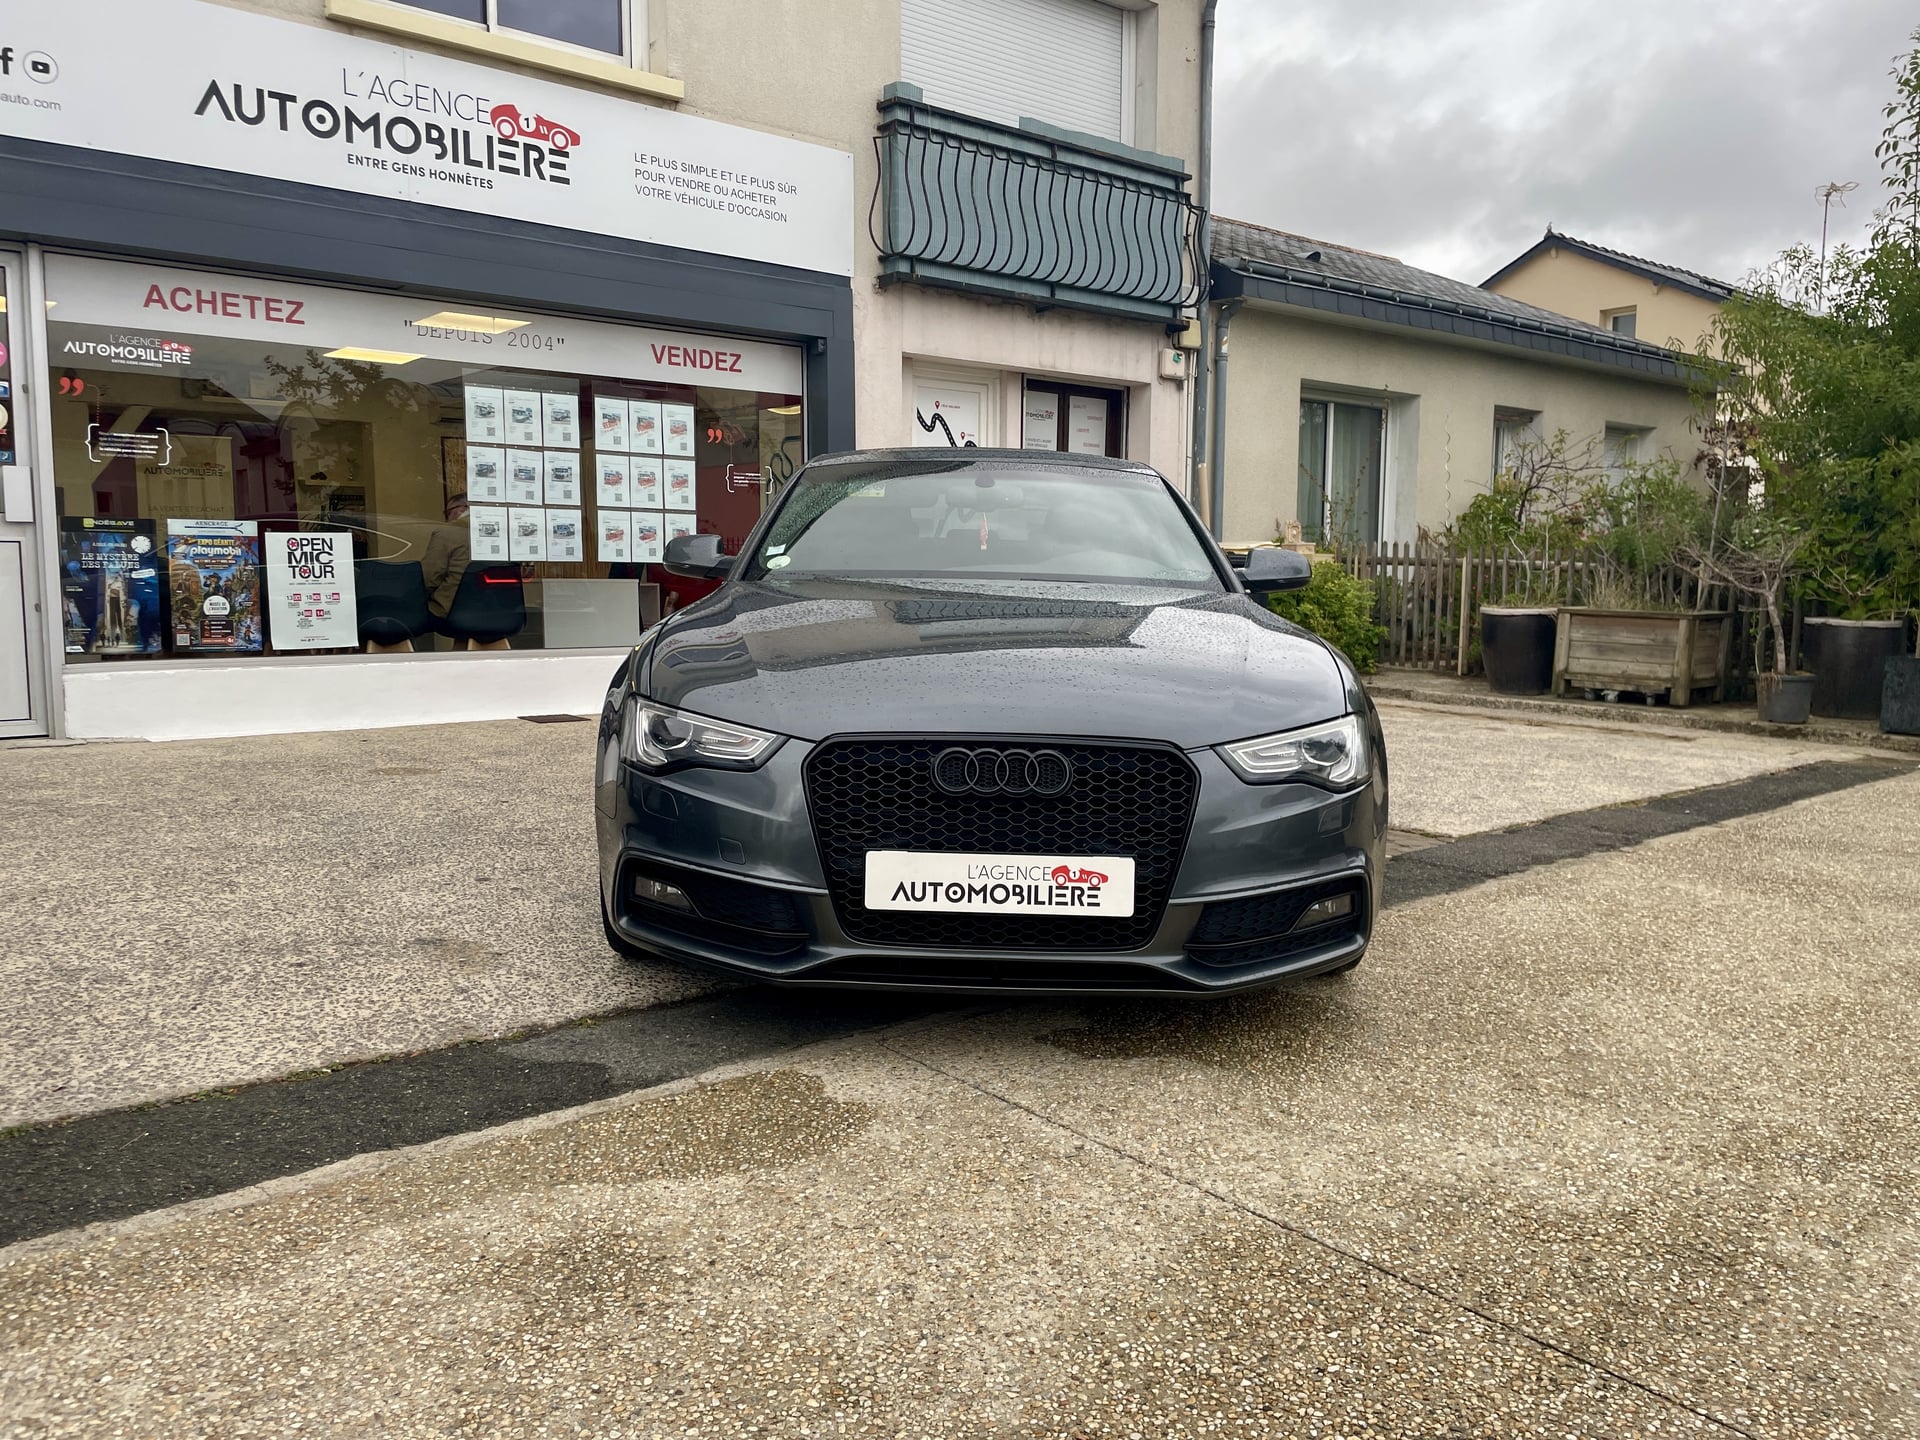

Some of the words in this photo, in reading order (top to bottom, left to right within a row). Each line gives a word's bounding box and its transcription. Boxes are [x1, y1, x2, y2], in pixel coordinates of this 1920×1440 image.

[343, 67, 491, 126] L'AGENCE
[523, 116, 531, 129] 1
[347, 153, 388, 171] ENTRE
[392, 160, 426, 178] GENS
[429, 170, 494, 190] HONNÊTES
[634, 152, 648, 165] LE
[650, 155, 678, 171] PLUS
[680, 162, 718, 179] SIMPLE
[720, 170, 733, 182] ET
[735, 173, 748, 185] LE
[750, 176, 775, 191] PLUS
[777, 182, 798, 196] SÛR
[634, 168, 666, 184] POUR
[668, 174, 711, 193] VENDRE
[713, 184, 729, 197] OU
[730, 187, 777, 206] ACHETER
[634, 184, 672, 201] VOTRE
[674, 191, 725, 211] VÉHICULE
[727, 202, 788, 224] D'OCCASION
[143, 283, 305, 325] ACHETEZ
[110, 334, 161, 348] L'AGENCE
[650, 343, 743, 374] VENDEZ
[190, 545, 242, 557] playmobil
[287, 537, 334, 552] OPEN
[81, 552, 95, 561] LE
[96, 550, 139, 561] MYSTÈRE
[287, 551, 334, 565] MIC
[81, 560, 101, 568] DES
[287, 565, 335, 579] TOUR
[967, 863, 1052, 882] L'AGENCE
[1071, 869, 1078, 879] 1
